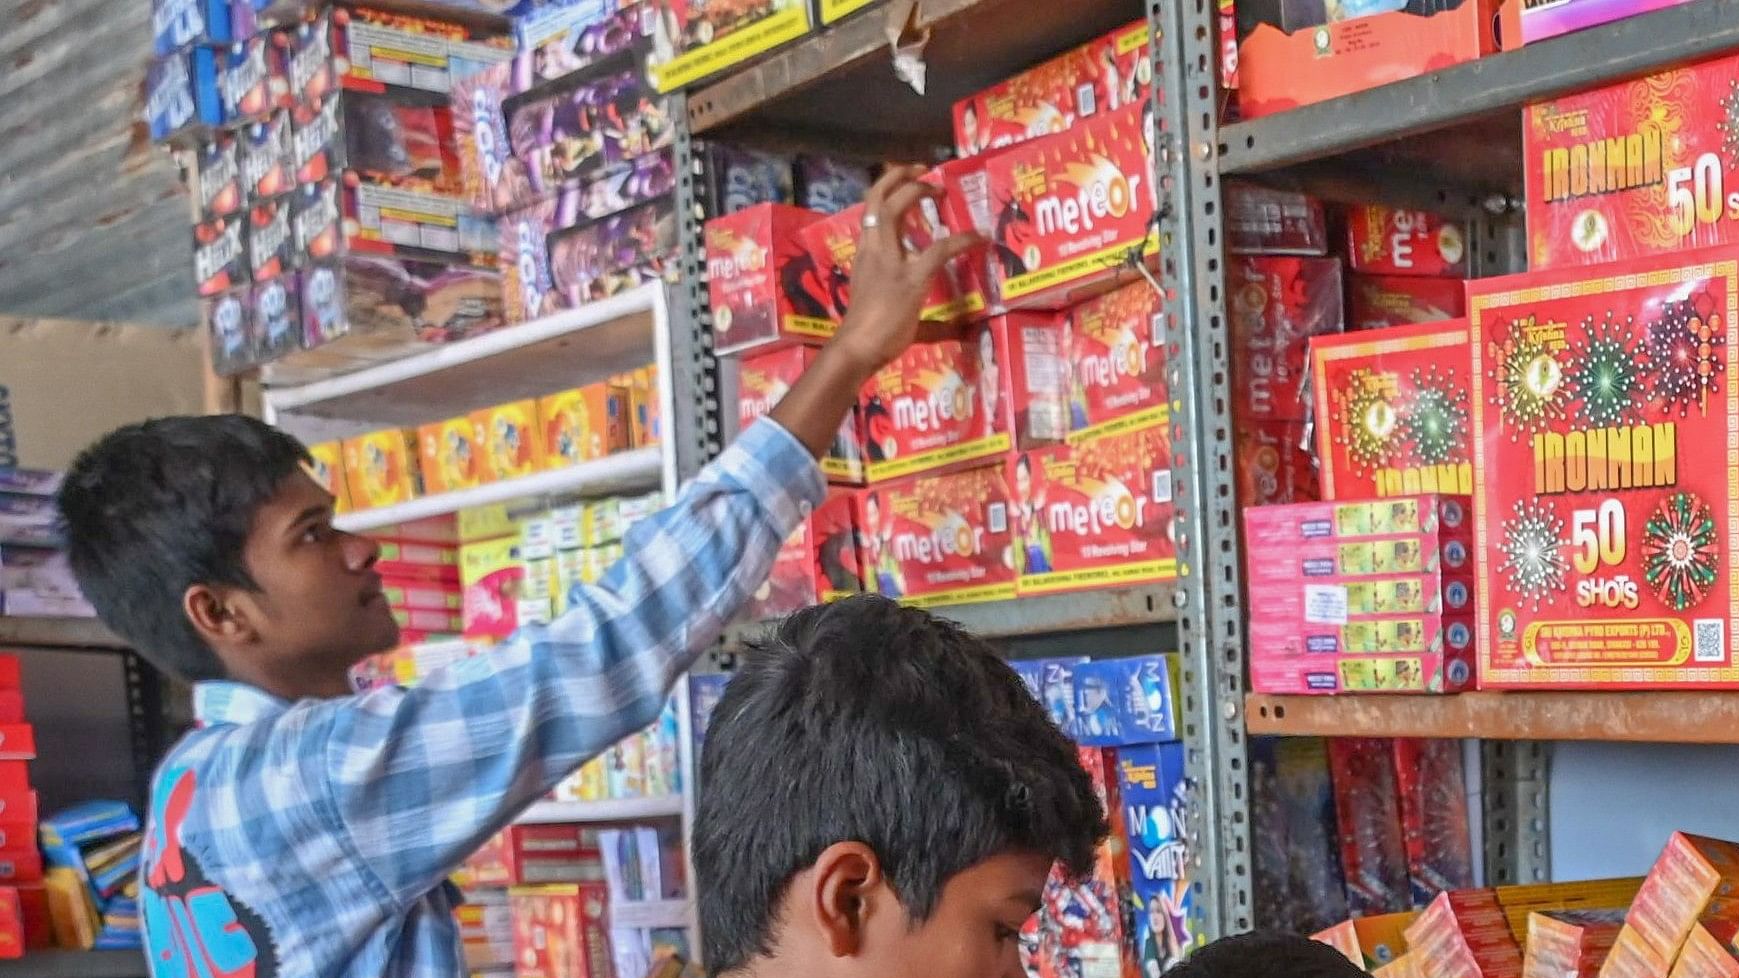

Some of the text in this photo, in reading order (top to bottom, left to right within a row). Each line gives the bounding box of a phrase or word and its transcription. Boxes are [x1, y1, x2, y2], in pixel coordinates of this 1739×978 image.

[1543, 129, 1664, 204] IRONMAN
[1666, 152, 1723, 237] 50
[1034, 169, 1142, 238] meteor
[1082, 340, 1149, 386] meteor
[893, 385, 975, 430] meteor
[1533, 423, 1677, 495] IRONMAN
[1050, 495, 1149, 537] meteor
[1570, 498, 1628, 575] 50
[895, 527, 985, 563] meteor
[1575, 573, 1640, 609] SHOTS
